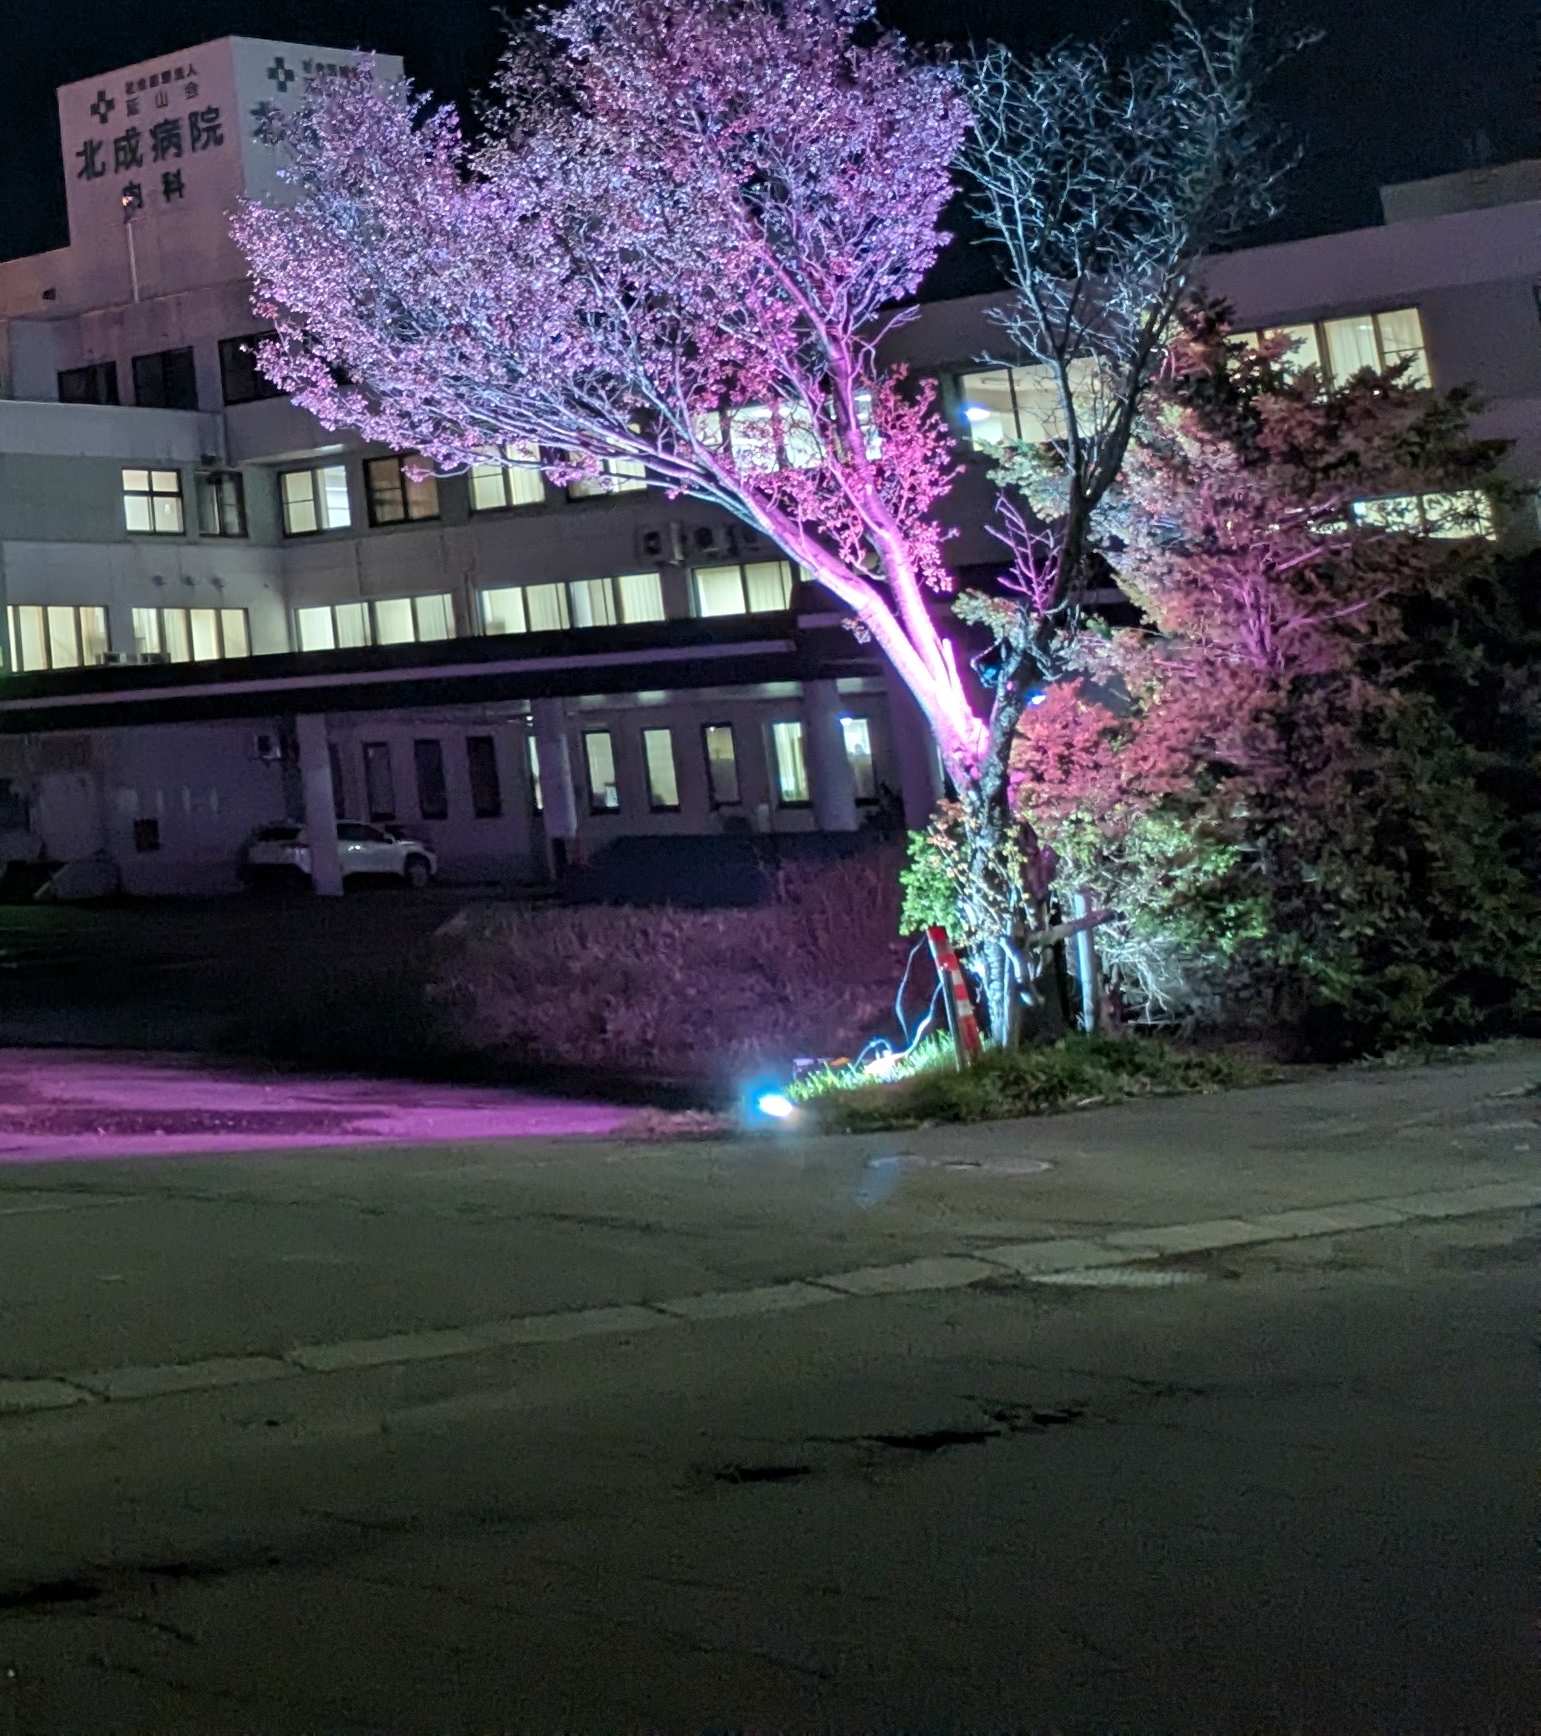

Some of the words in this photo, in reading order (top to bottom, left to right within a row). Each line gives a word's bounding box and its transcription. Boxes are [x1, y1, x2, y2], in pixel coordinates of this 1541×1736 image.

[75, 106, 224, 181] 北成病院
[123, 169, 185, 208] 内科
